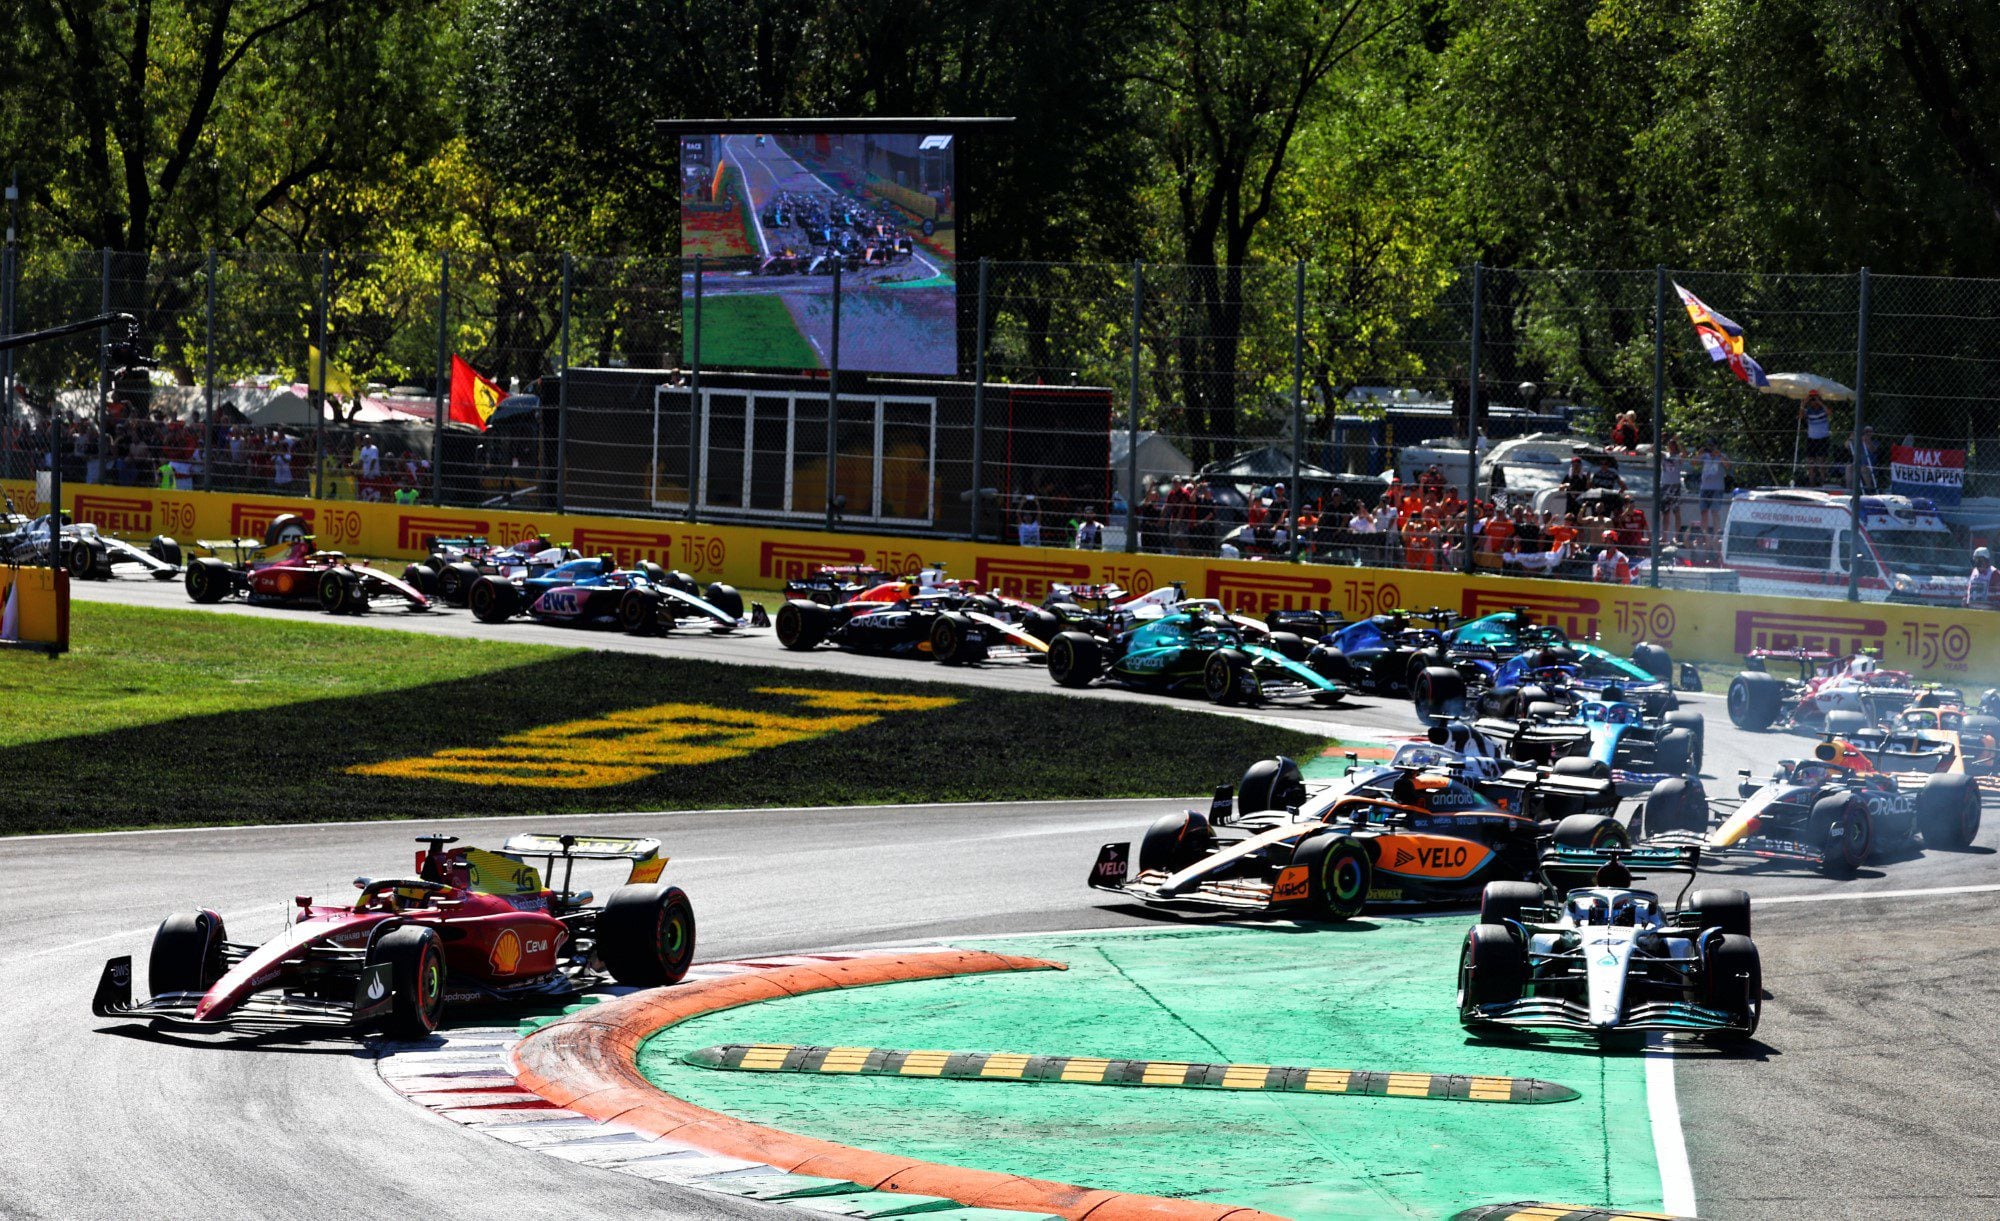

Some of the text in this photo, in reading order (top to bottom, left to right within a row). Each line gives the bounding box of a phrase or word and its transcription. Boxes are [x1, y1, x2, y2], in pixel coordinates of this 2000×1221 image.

[919, 135, 953, 149] F1
[1914, 451, 1942, 466] MAX
[1895, 465, 1962, 486] VERSTAPPEN
[74, 494, 196, 534] PIRELLI 150
[324, 509, 362, 545] 150
[682, 535, 726, 573] 150
[1205, 569, 1400, 616] PIRELLI 150
[544, 592, 578, 612] BWT
[850, 615, 904, 629] ORACLE
[1146, 622, 1180, 636] aramco
[1472, 620, 1506, 632] aramco
[1614, 601, 1676, 644] 150
[1902, 622, 1971, 669] 150
[1126, 655, 1164, 670] cognizant
[1943, 662, 1969, 672] YEARS
[1432, 791, 1474, 805] android
[1868, 797, 1915, 816] ORACLE
[1418, 847, 1467, 868] VELO
[1099, 861, 1127, 876] VELO
[512, 867, 535, 891] 16
[1275, 881, 1307, 896] VELO
[336, 932, 360, 942] RICHARD
[257, 969, 281, 985] Santander
